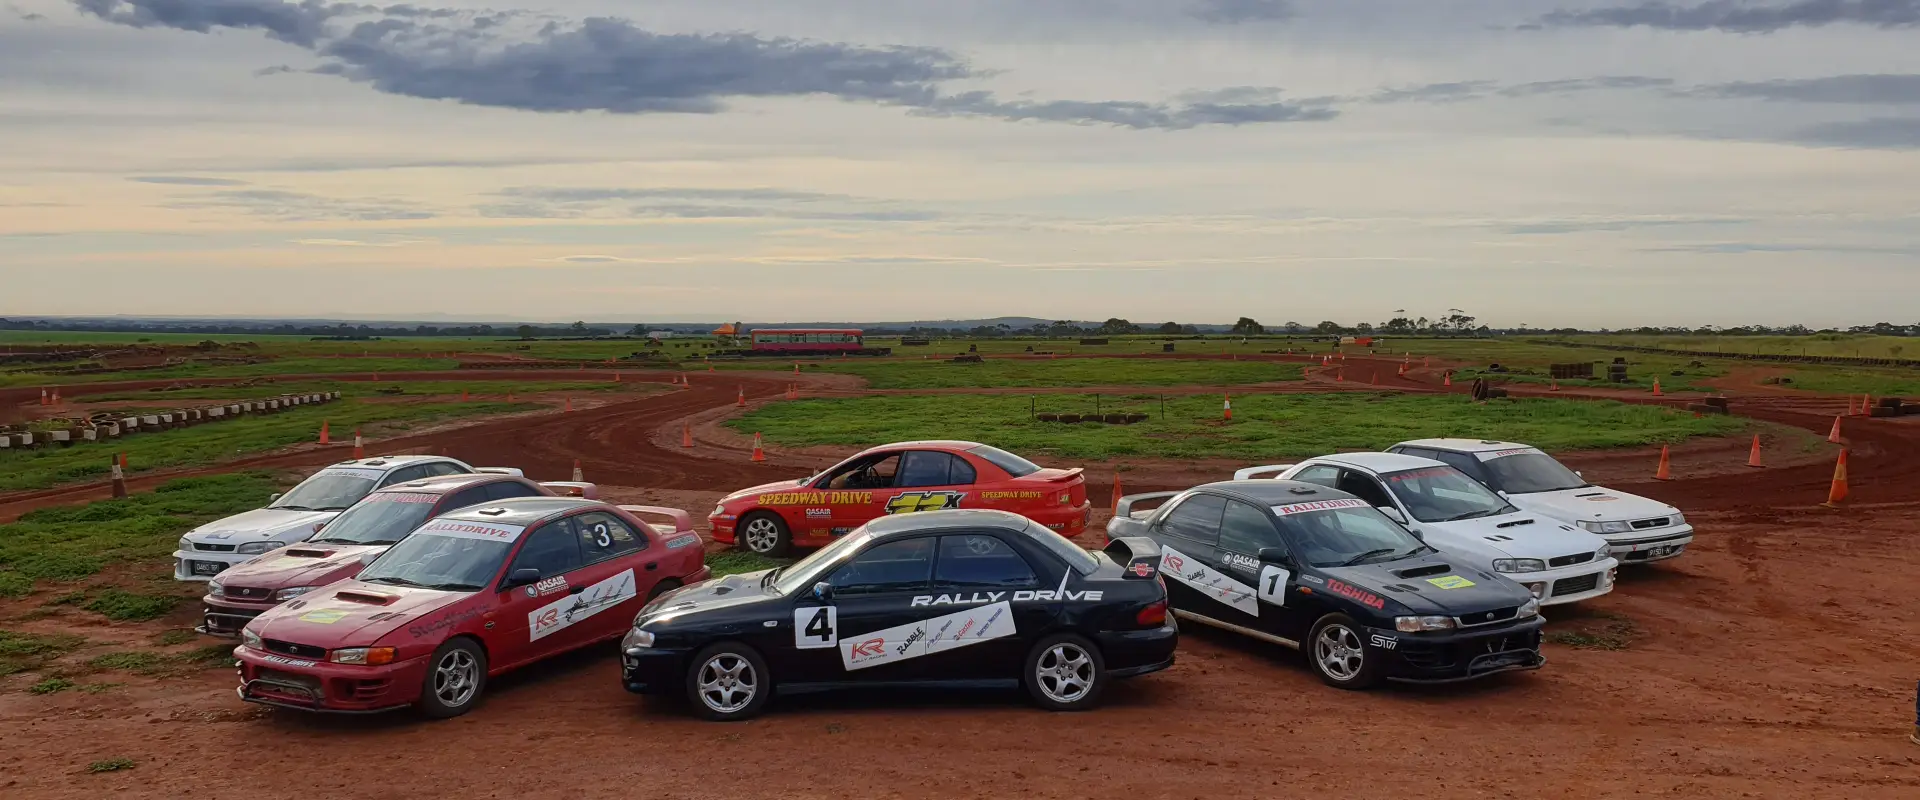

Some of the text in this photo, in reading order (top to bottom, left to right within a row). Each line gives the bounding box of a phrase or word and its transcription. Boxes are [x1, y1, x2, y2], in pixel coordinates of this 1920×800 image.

[758, 491, 873, 505] SPEEDWAY DRIVE
[981, 491, 1019, 499] SPEEDWAY
[806, 508, 831, 516] QASAIR
[424, 522, 511, 539] RALLYDRIVE
[594, 524, 610, 547] 3
[1233, 554, 1261, 569] QASAIR
[537, 576, 567, 591] QASAIR
[910, 565, 1104, 607] RALLY DRIVE
[1268, 573, 1280, 596] 1
[1327, 578, 1386, 610] TOSHIBA
[535, 607, 559, 631] KR
[804, 608, 833, 642] 4
[957, 616, 975, 638] Castrol
[852, 637, 885, 660] KR
[896, 627, 923, 655] RABBLE
